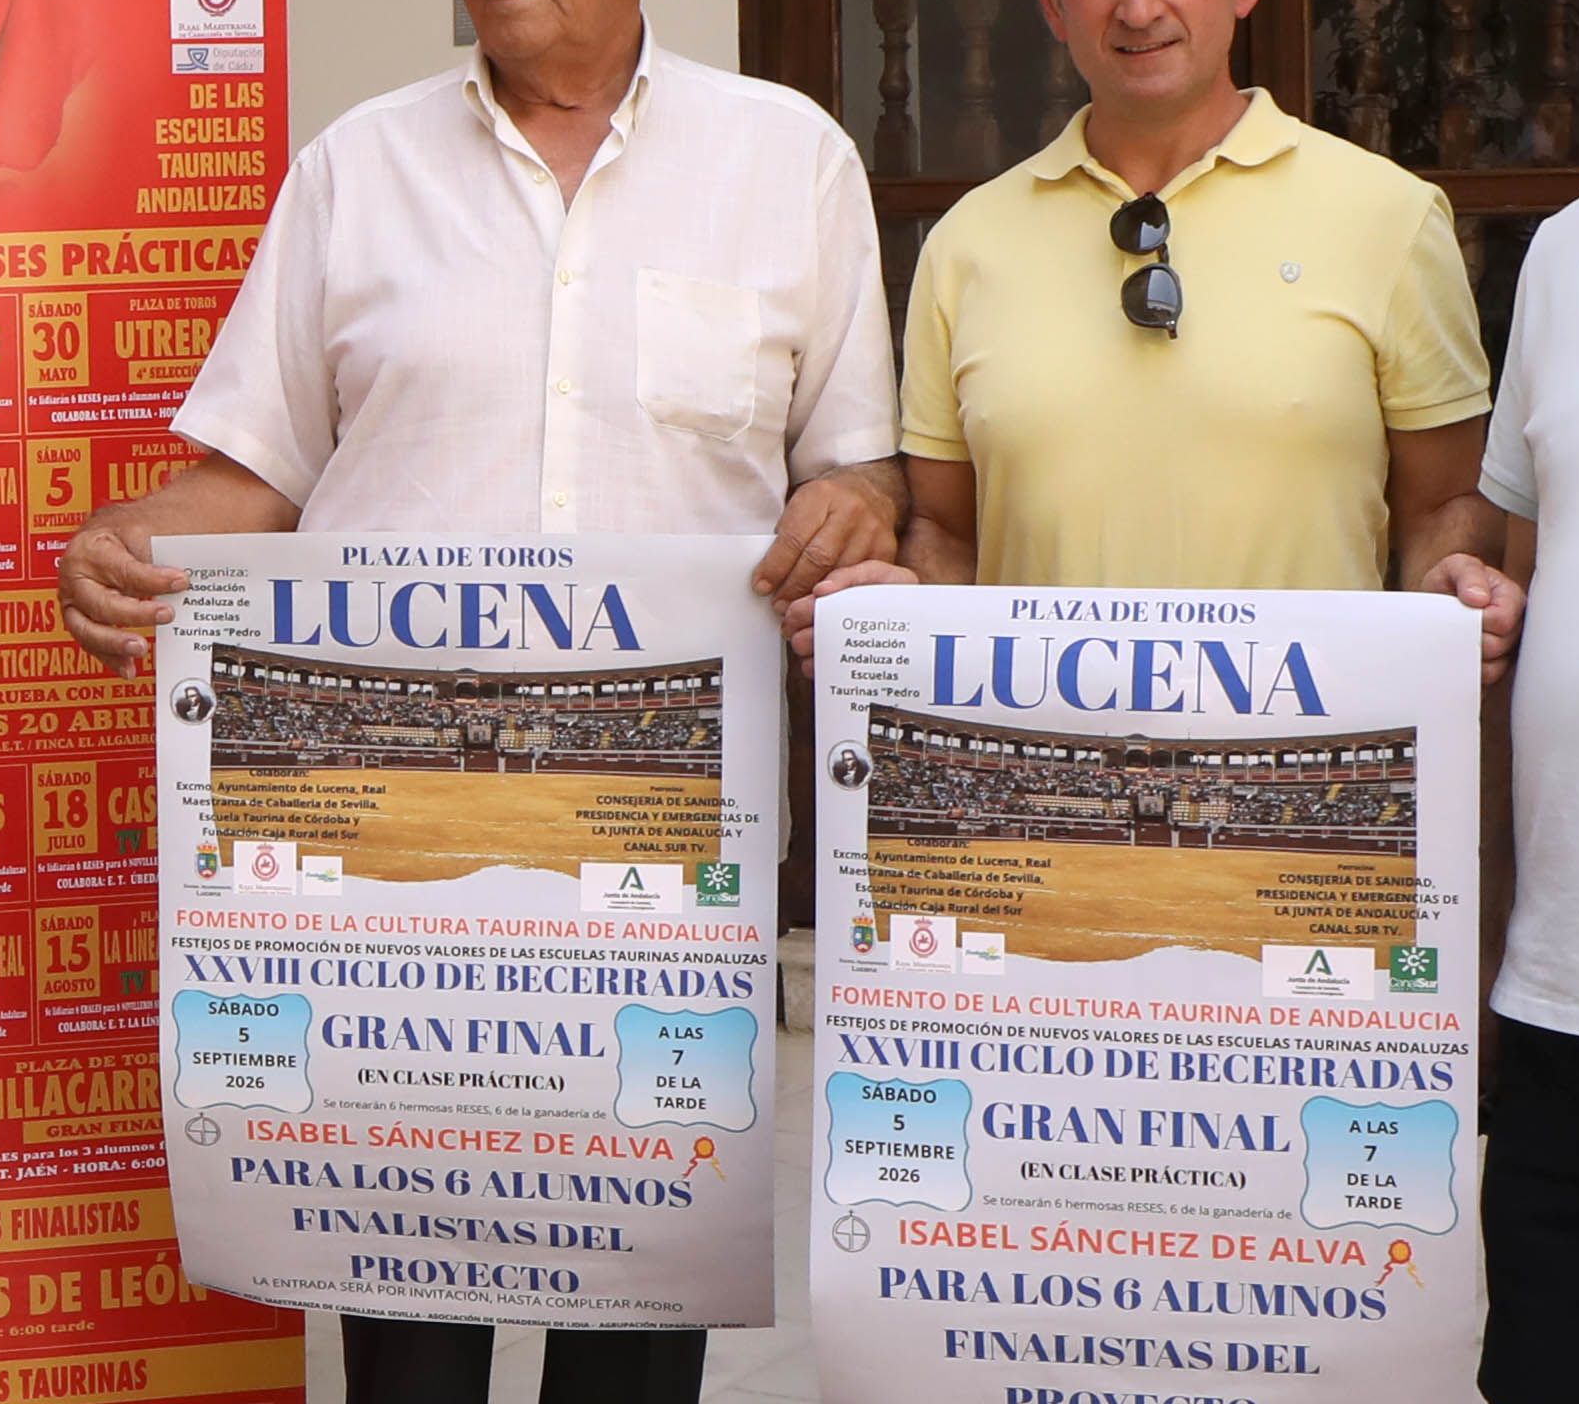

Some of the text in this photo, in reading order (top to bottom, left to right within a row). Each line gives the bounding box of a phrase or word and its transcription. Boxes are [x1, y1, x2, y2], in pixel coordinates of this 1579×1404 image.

[190, 82, 264, 109] DE LAS
[155, 116, 264, 144] ESCUELAS
[157, 150, 265, 178] TAURINAS
[136, 185, 265, 213] ANDALUZAS
[343, 547, 573, 567] PLAZA DE TOROS
[268, 579, 643, 651] LUCENA
[1011, 599, 1255, 623] PLAZA DE TOROS
[928, 635, 1330, 717] LUCENA
[874, 851, 957, 864] Ayuntamiento
[960, 855, 974, 865] de
[1026, 858, 1051, 868] Real
[1356, 876, 1372, 886] DE
[172, 937, 767, 965] FESTEJOS DE PROMOCIÓN DE NUEVOS VALORES DE LAS ESCUELAS TAURINAS ANDALUZAS
[12, 1199, 141, 1240] FINALISTAS
[29, 1271, 82, 1315] DE
[945, 1330, 1320, 1374] FINALISTAS DEL
